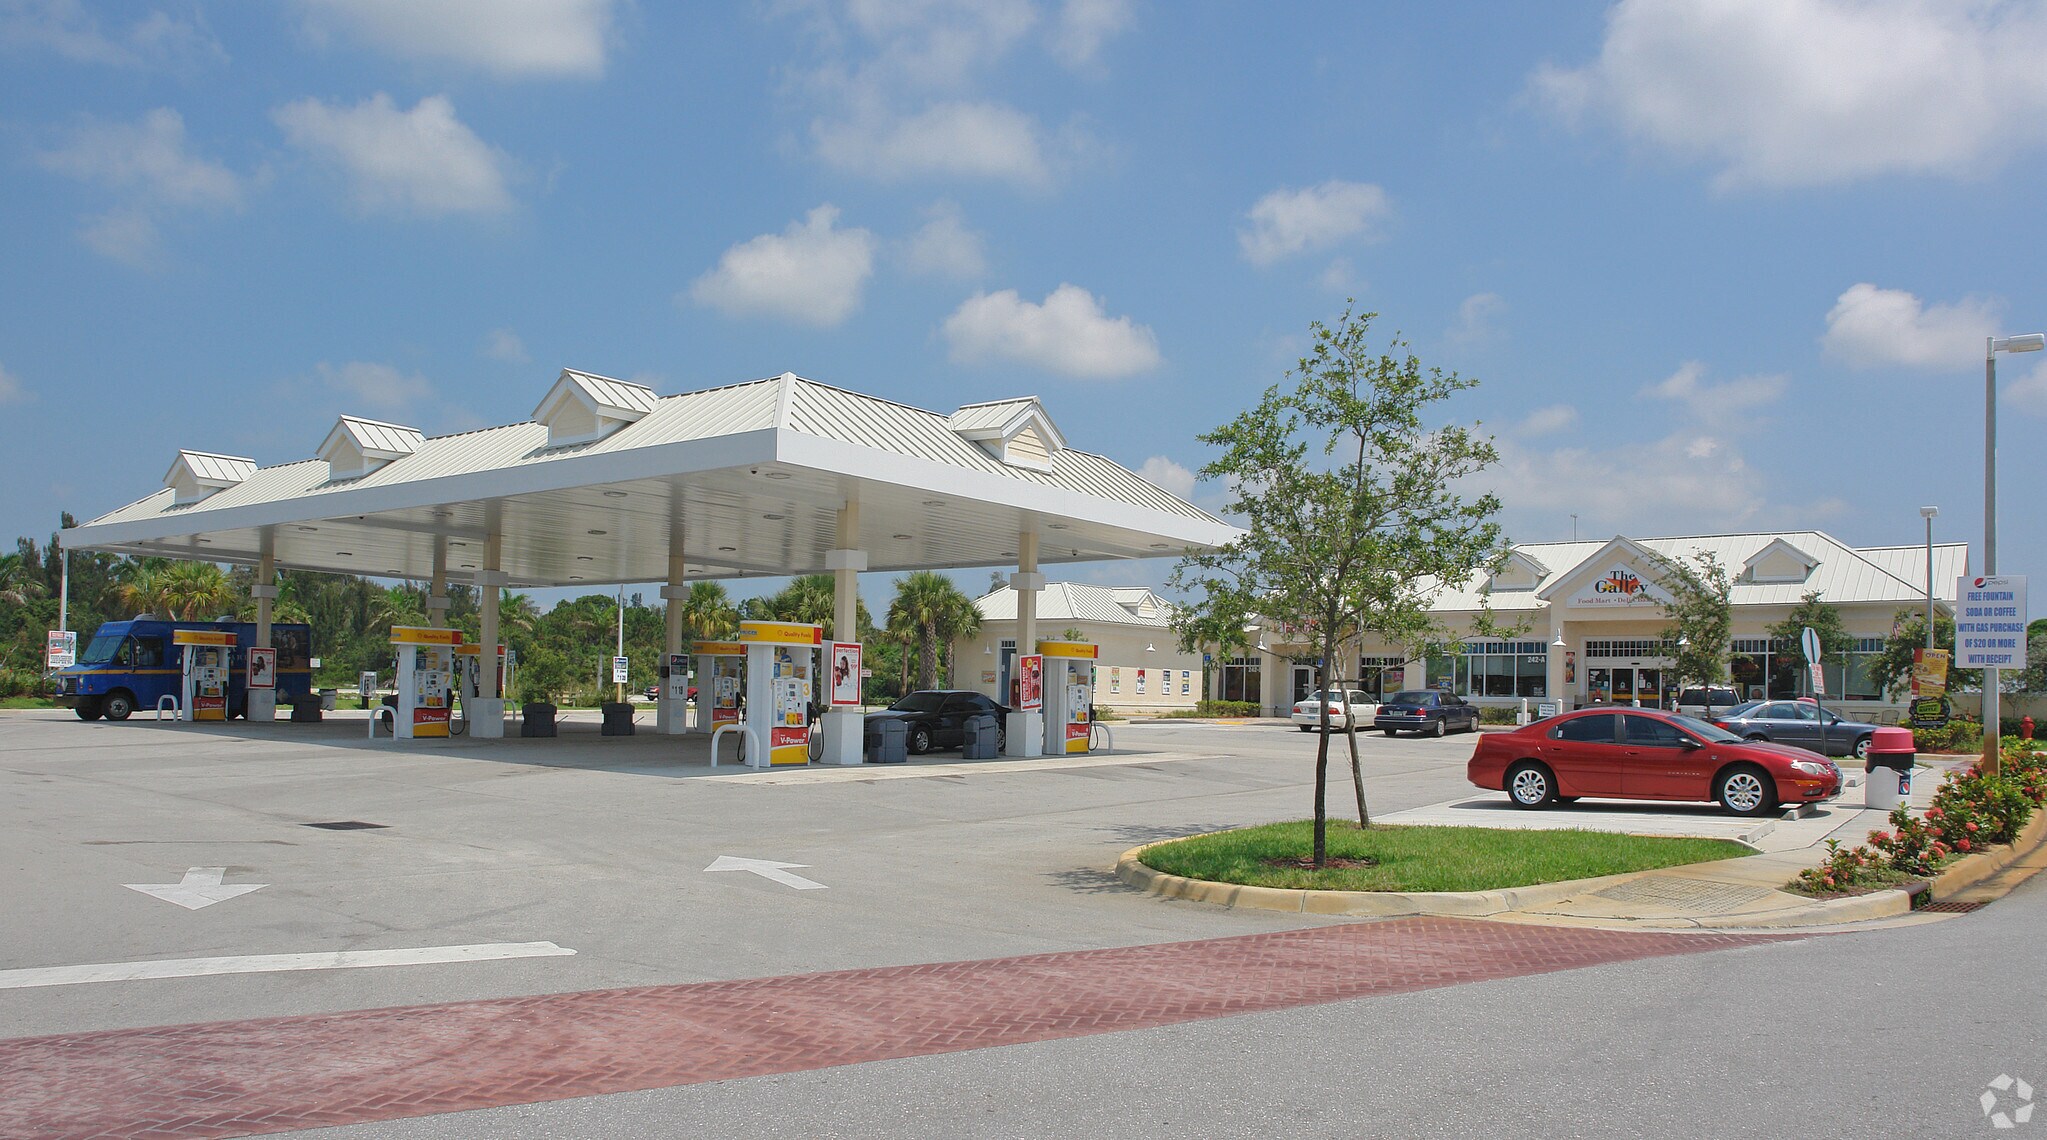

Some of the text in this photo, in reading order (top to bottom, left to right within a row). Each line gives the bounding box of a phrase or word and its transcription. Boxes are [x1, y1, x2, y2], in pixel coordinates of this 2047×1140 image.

[1610, 570, 1636, 580] The
[1594, 580, 1649, 594] Galley
[1967, 591, 2014, 601] FREE FOUNTAIN
[1965, 607, 2017, 617] SODA OR COFFEE
[1957, 622, 2024, 633] WITH GAS PURCHASE
[1964, 638, 2016, 648] OF $20 OR MORE
[1967, 654, 2012, 664] WITH RECEIPT
[443, 674, 451, 684] 7
[733, 680, 739, 688] 5
[803, 683, 810, 696] 3
[780, 736, 805, 744] V-Power
